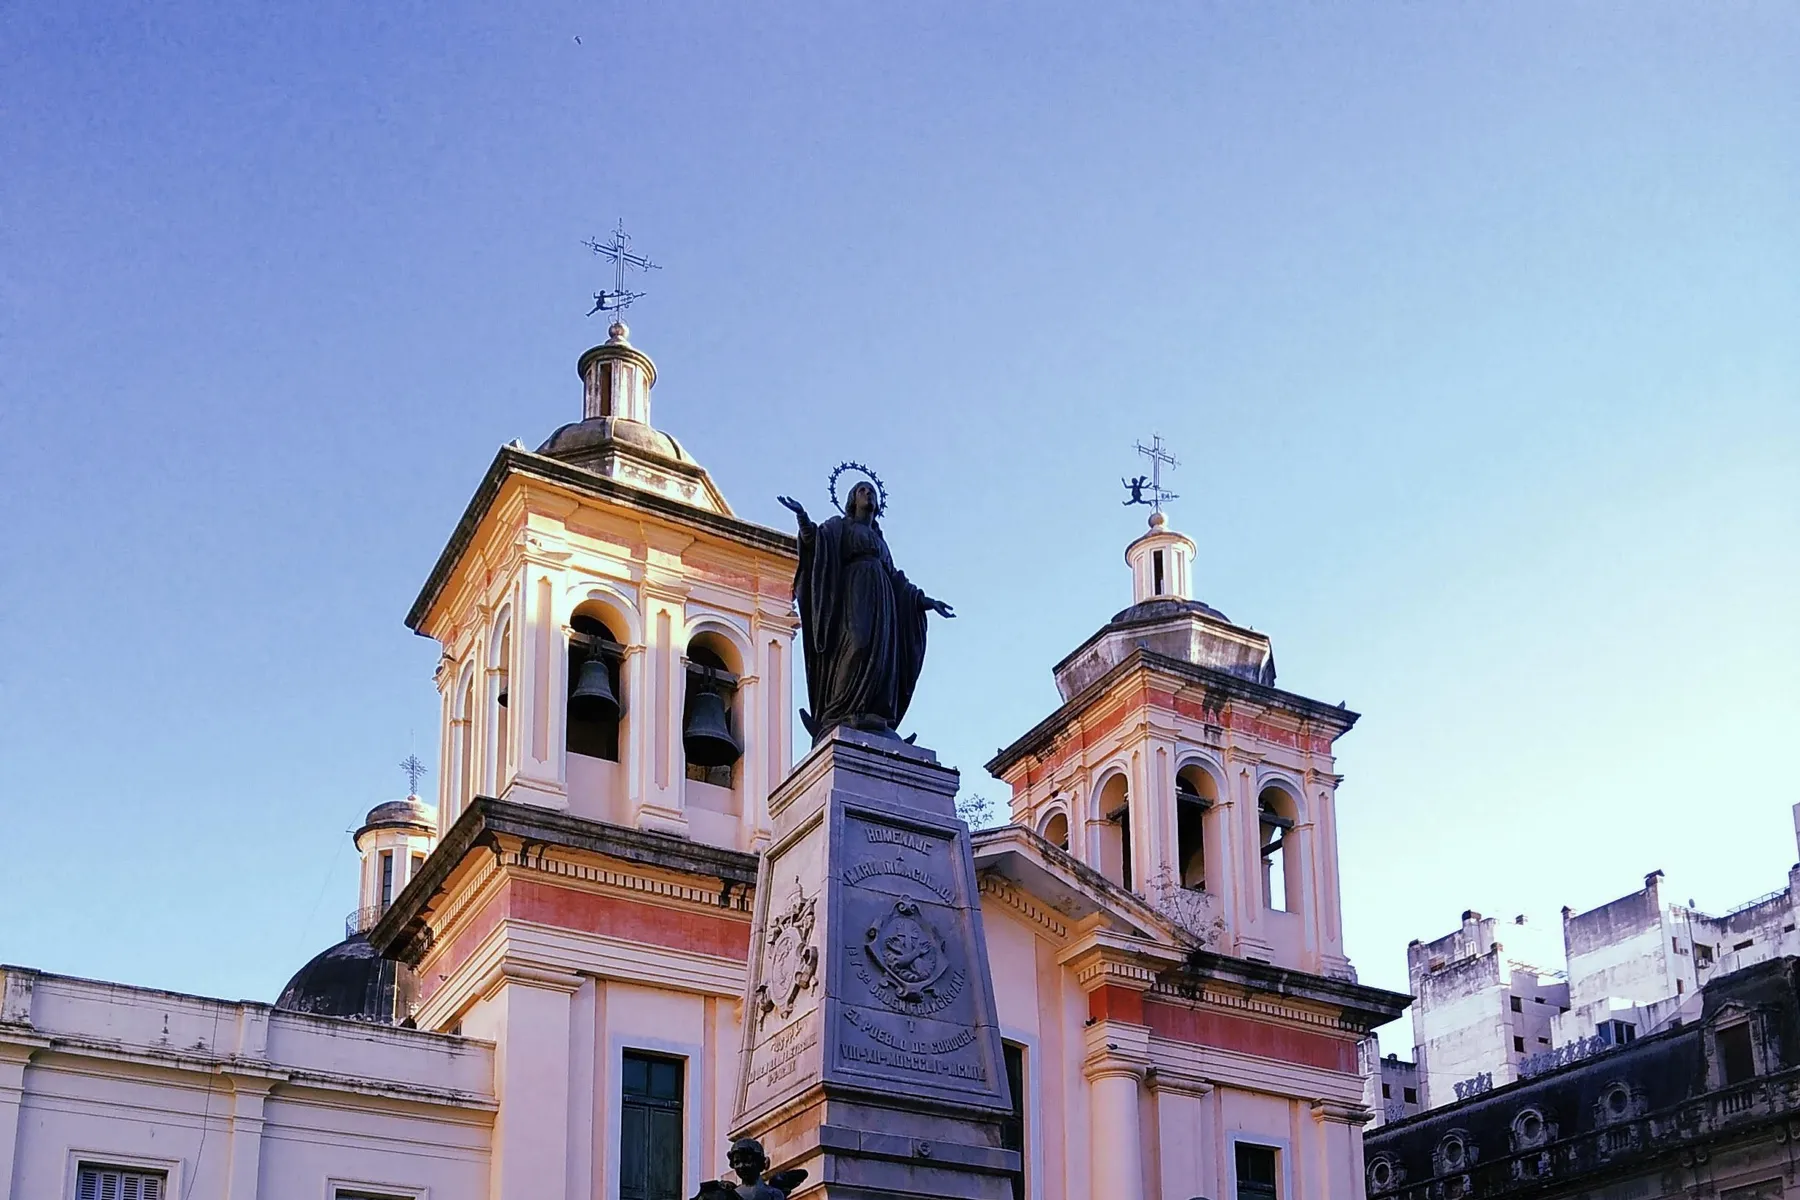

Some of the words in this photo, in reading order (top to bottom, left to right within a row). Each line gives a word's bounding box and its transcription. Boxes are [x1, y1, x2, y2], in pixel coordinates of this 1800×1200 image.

[865, 827, 933, 856] HOMENAJE
[843, 861, 882, 886] MARIA
[843, 1008, 859, 1026] EL
[861, 1021, 907, 1052] PUEBLO
[911, 1042, 927, 1055] DE
